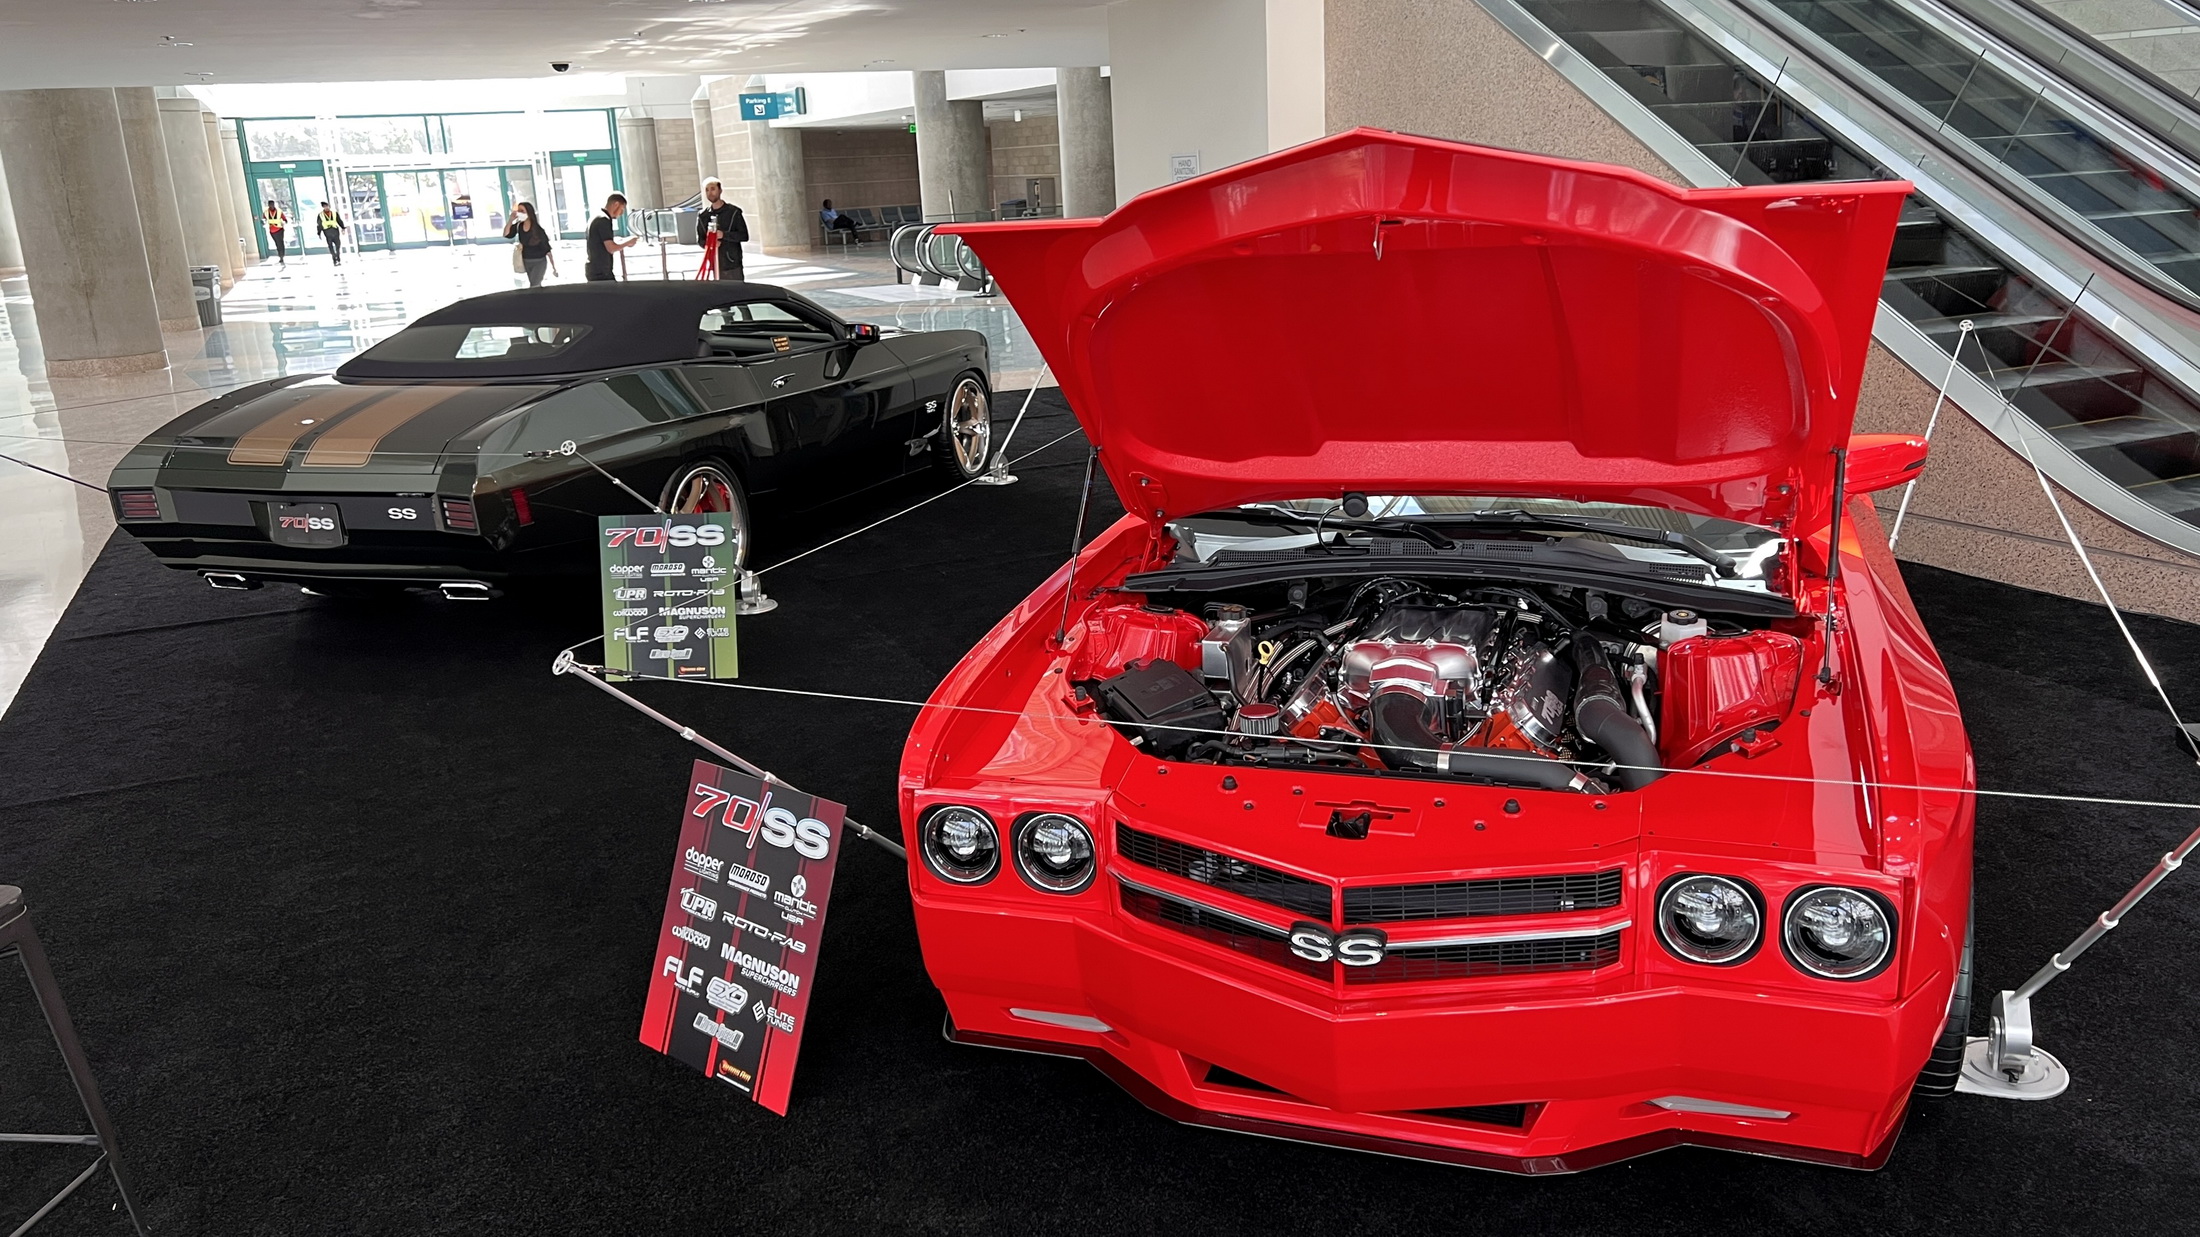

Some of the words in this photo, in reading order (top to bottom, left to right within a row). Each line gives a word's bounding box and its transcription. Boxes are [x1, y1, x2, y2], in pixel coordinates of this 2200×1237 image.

[1178, 159, 1191, 167] HAND
[388, 508, 417, 520] SS
[609, 564, 644, 575] dapper
[652, 563, 683, 571] MOROSO
[691, 567, 727, 575] mantic
[616, 589, 646, 599] UPR
[659, 607, 726, 616] MAGNUSON
[614, 627, 649, 641] FLF
[685, 846, 724, 871] dapper
[730, 865, 768, 886] MOROSO
[683, 892, 716, 916] UPR
[773, 890, 817, 915] mantic
[781, 911, 804, 926] USA
[672, 925, 710, 949] wilwood
[720, 943, 800, 989] MAGNUSON
[1289, 928, 1385, 966] SS
[663, 955, 704, 988] FLF
[767, 1006, 795, 1025] ELITE
[741, 967, 797, 997] SUPERCHARGERS
[766, 1014, 793, 1033] TUNED
